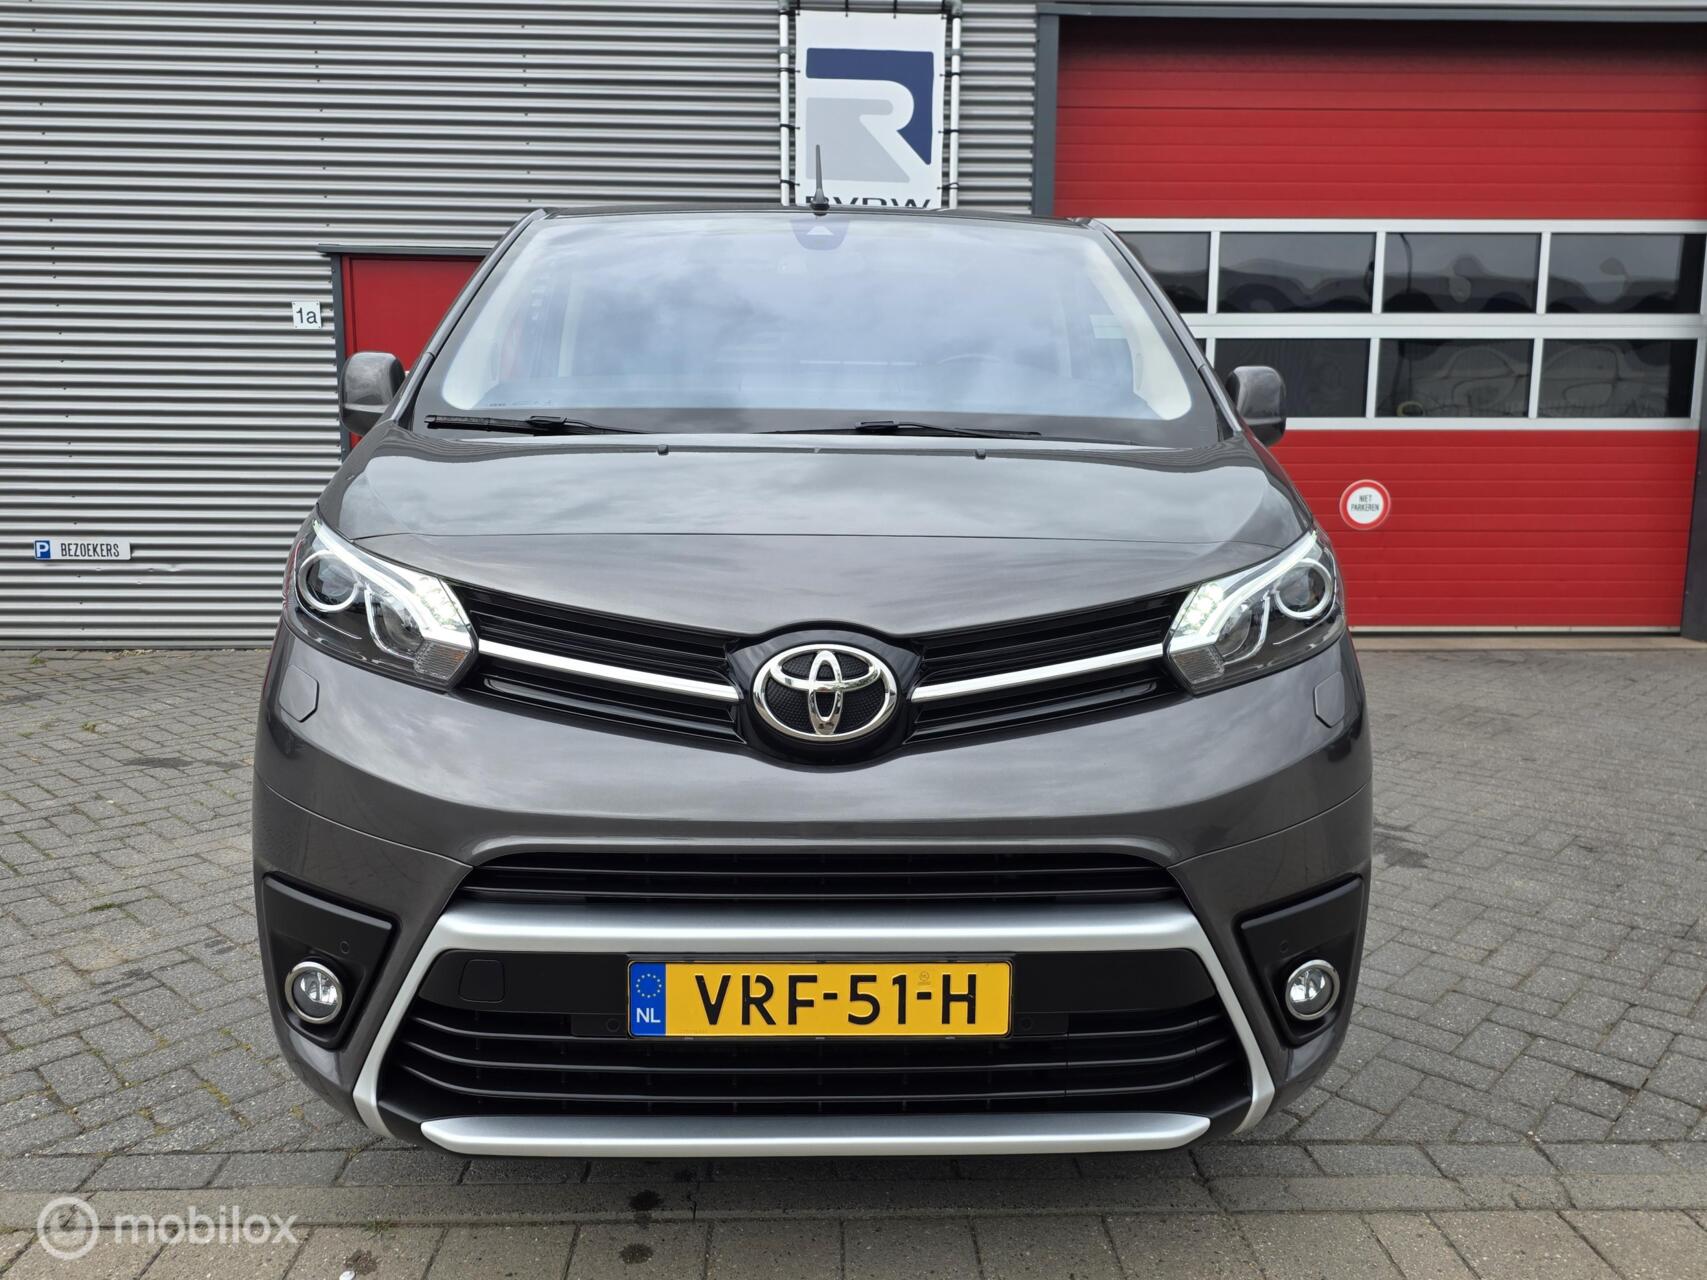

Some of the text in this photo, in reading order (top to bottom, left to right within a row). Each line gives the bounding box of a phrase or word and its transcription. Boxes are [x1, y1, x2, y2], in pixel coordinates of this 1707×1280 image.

[296, 307, 318, 324] 1a
[1359, 494, 1373, 502] NIET
[1350, 503, 1380, 512] PARKEREN
[36, 541, 120, 558] P BEZOEKERS
[636, 974, 977, 1026] NL VRF-51-H
